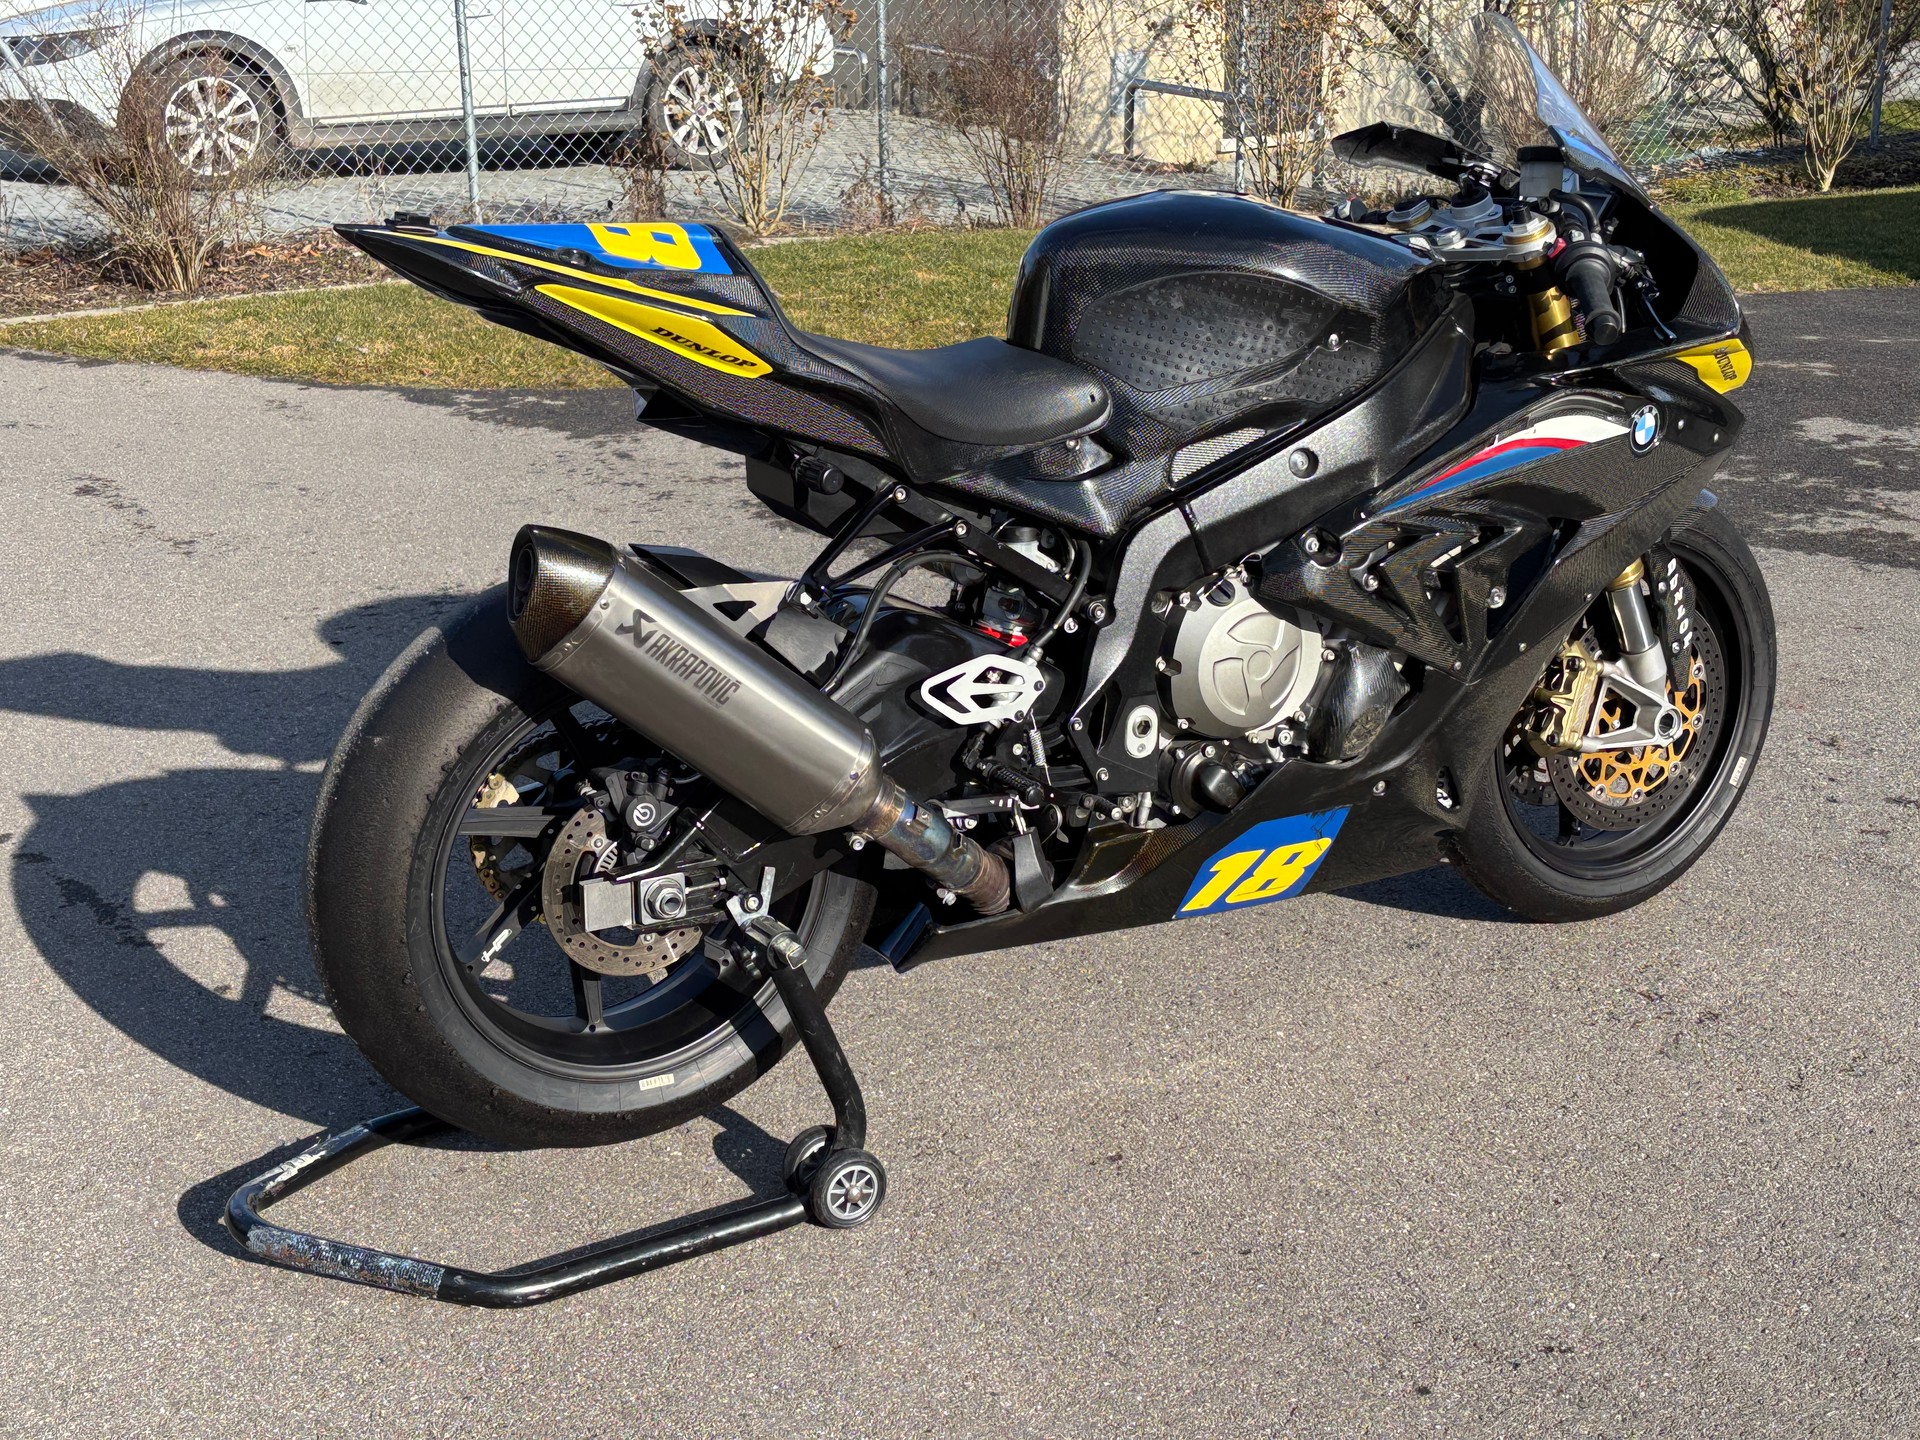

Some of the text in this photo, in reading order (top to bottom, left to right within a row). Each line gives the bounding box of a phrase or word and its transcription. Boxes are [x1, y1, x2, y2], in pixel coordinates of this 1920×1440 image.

[650, 327, 757, 367] DUNLOP
[1713, 347, 1738, 381] DUNLOP
[1667, 558, 1693, 649] DUNLOP
[1181, 838, 1332, 912] 18
